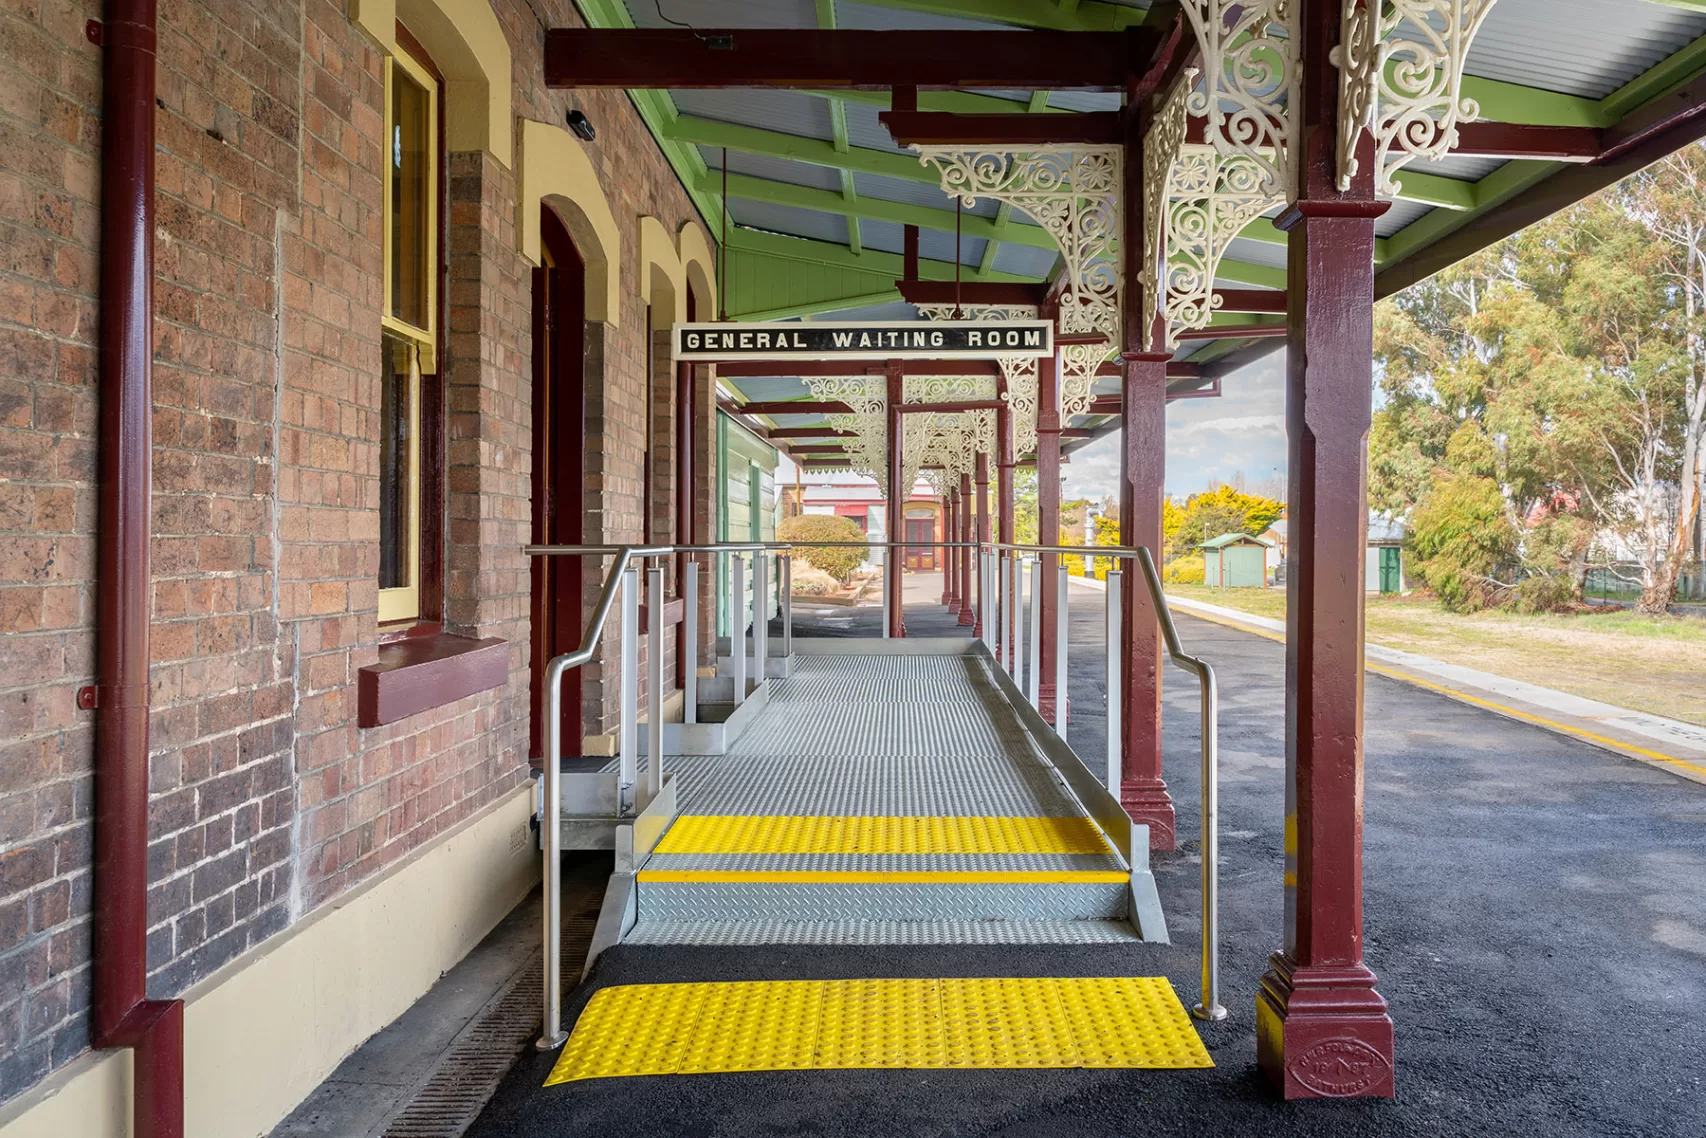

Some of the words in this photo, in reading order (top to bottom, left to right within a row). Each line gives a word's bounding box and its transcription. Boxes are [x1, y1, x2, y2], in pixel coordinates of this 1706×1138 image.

[687, 333, 807, 348] GENERAL
[832, 332, 945, 347] WAITING
[968, 331, 1041, 346] ROOM
